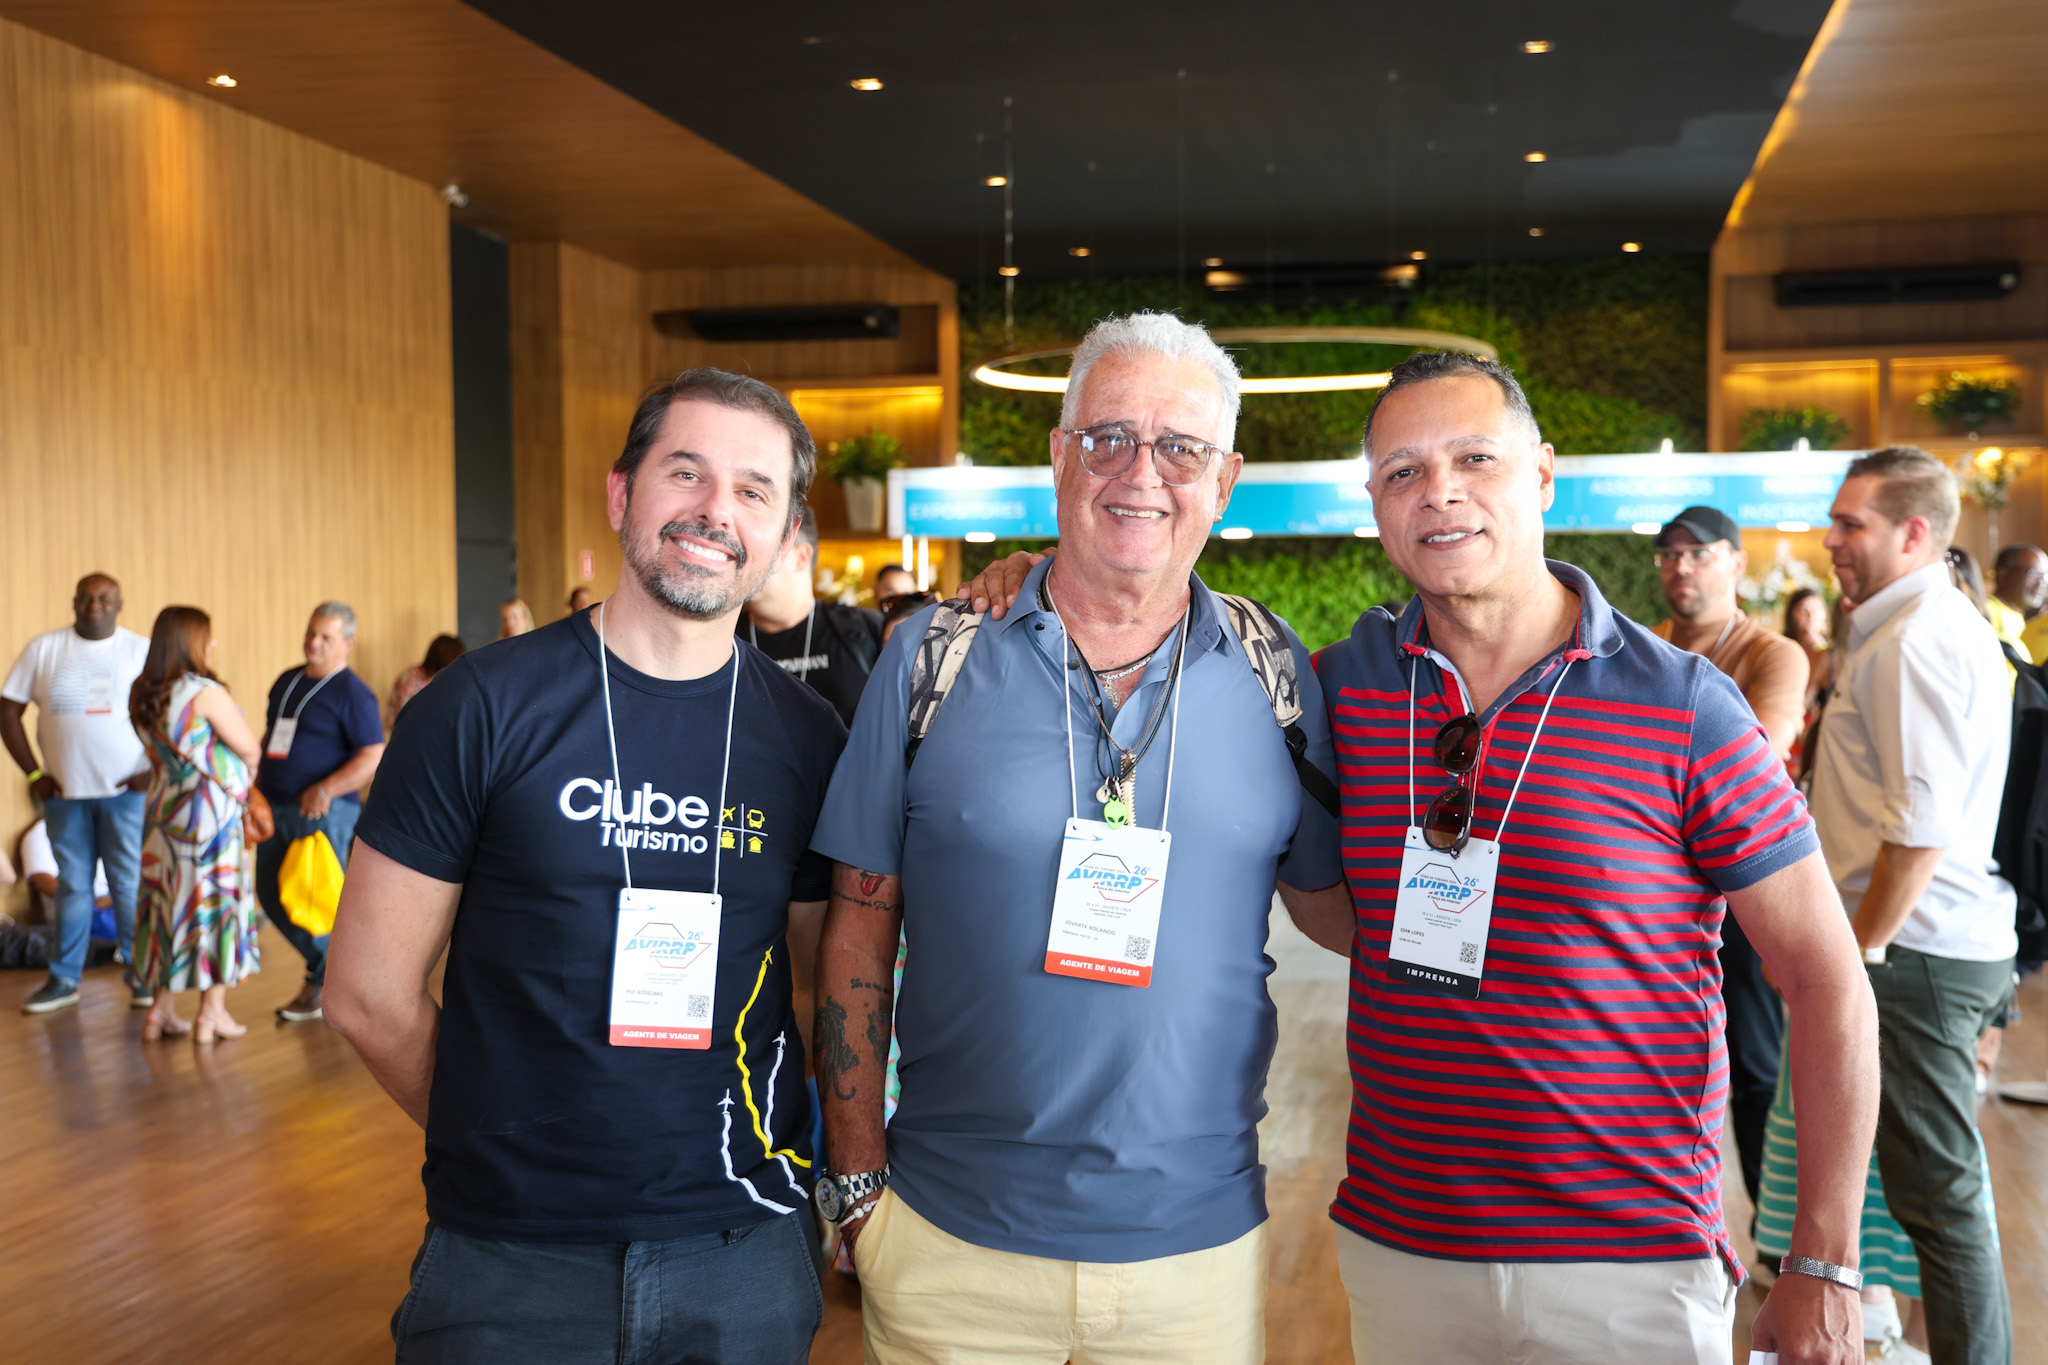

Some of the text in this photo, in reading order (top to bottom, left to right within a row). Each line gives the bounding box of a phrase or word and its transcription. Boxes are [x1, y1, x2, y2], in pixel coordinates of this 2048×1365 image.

[559, 777, 710, 829] Clube
[601, 822, 708, 854] Turismo
[1066, 868, 1142, 890] AVIRRP
[1404, 877, 1472, 901] AVIRRP
[623, 938, 696, 956] AVIRRP
[1060, 959, 1140, 977] AGENTE DE VIAGEM
[1406, 967, 1459, 986] IMPRENSA
[623, 1031, 655, 1039] AGENTE
